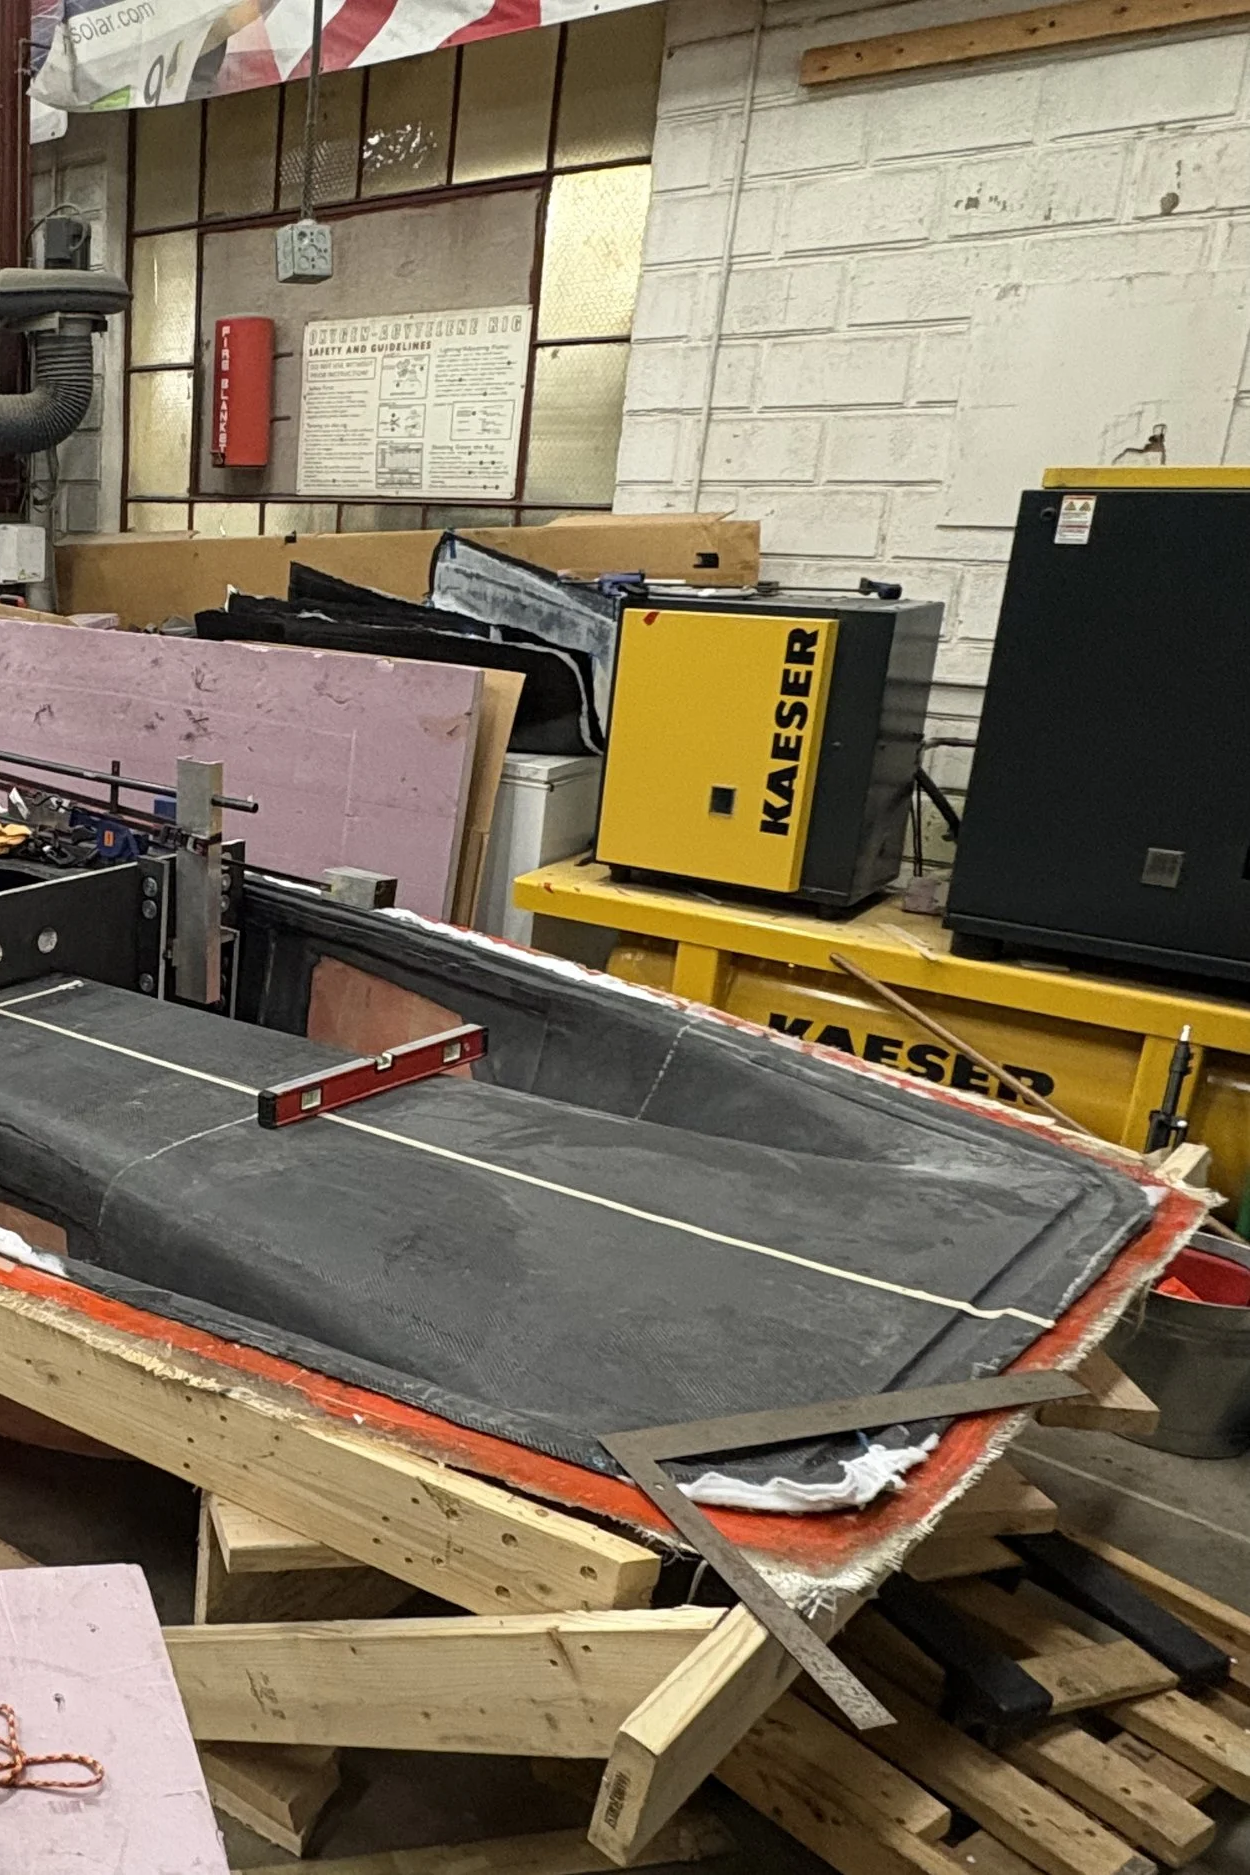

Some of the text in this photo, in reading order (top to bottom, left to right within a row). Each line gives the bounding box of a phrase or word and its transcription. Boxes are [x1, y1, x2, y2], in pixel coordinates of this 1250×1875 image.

[64, 2, 156, 52] solar.com
[309, 341, 432, 357] SAFETY AND GUIDELINES
[488, 315, 523, 333] RIG
[218, 326, 230, 452] FIRE BLANKET
[760, 628, 819, 836] KAESER
[768, 1012, 1055, 1106] KAESER
